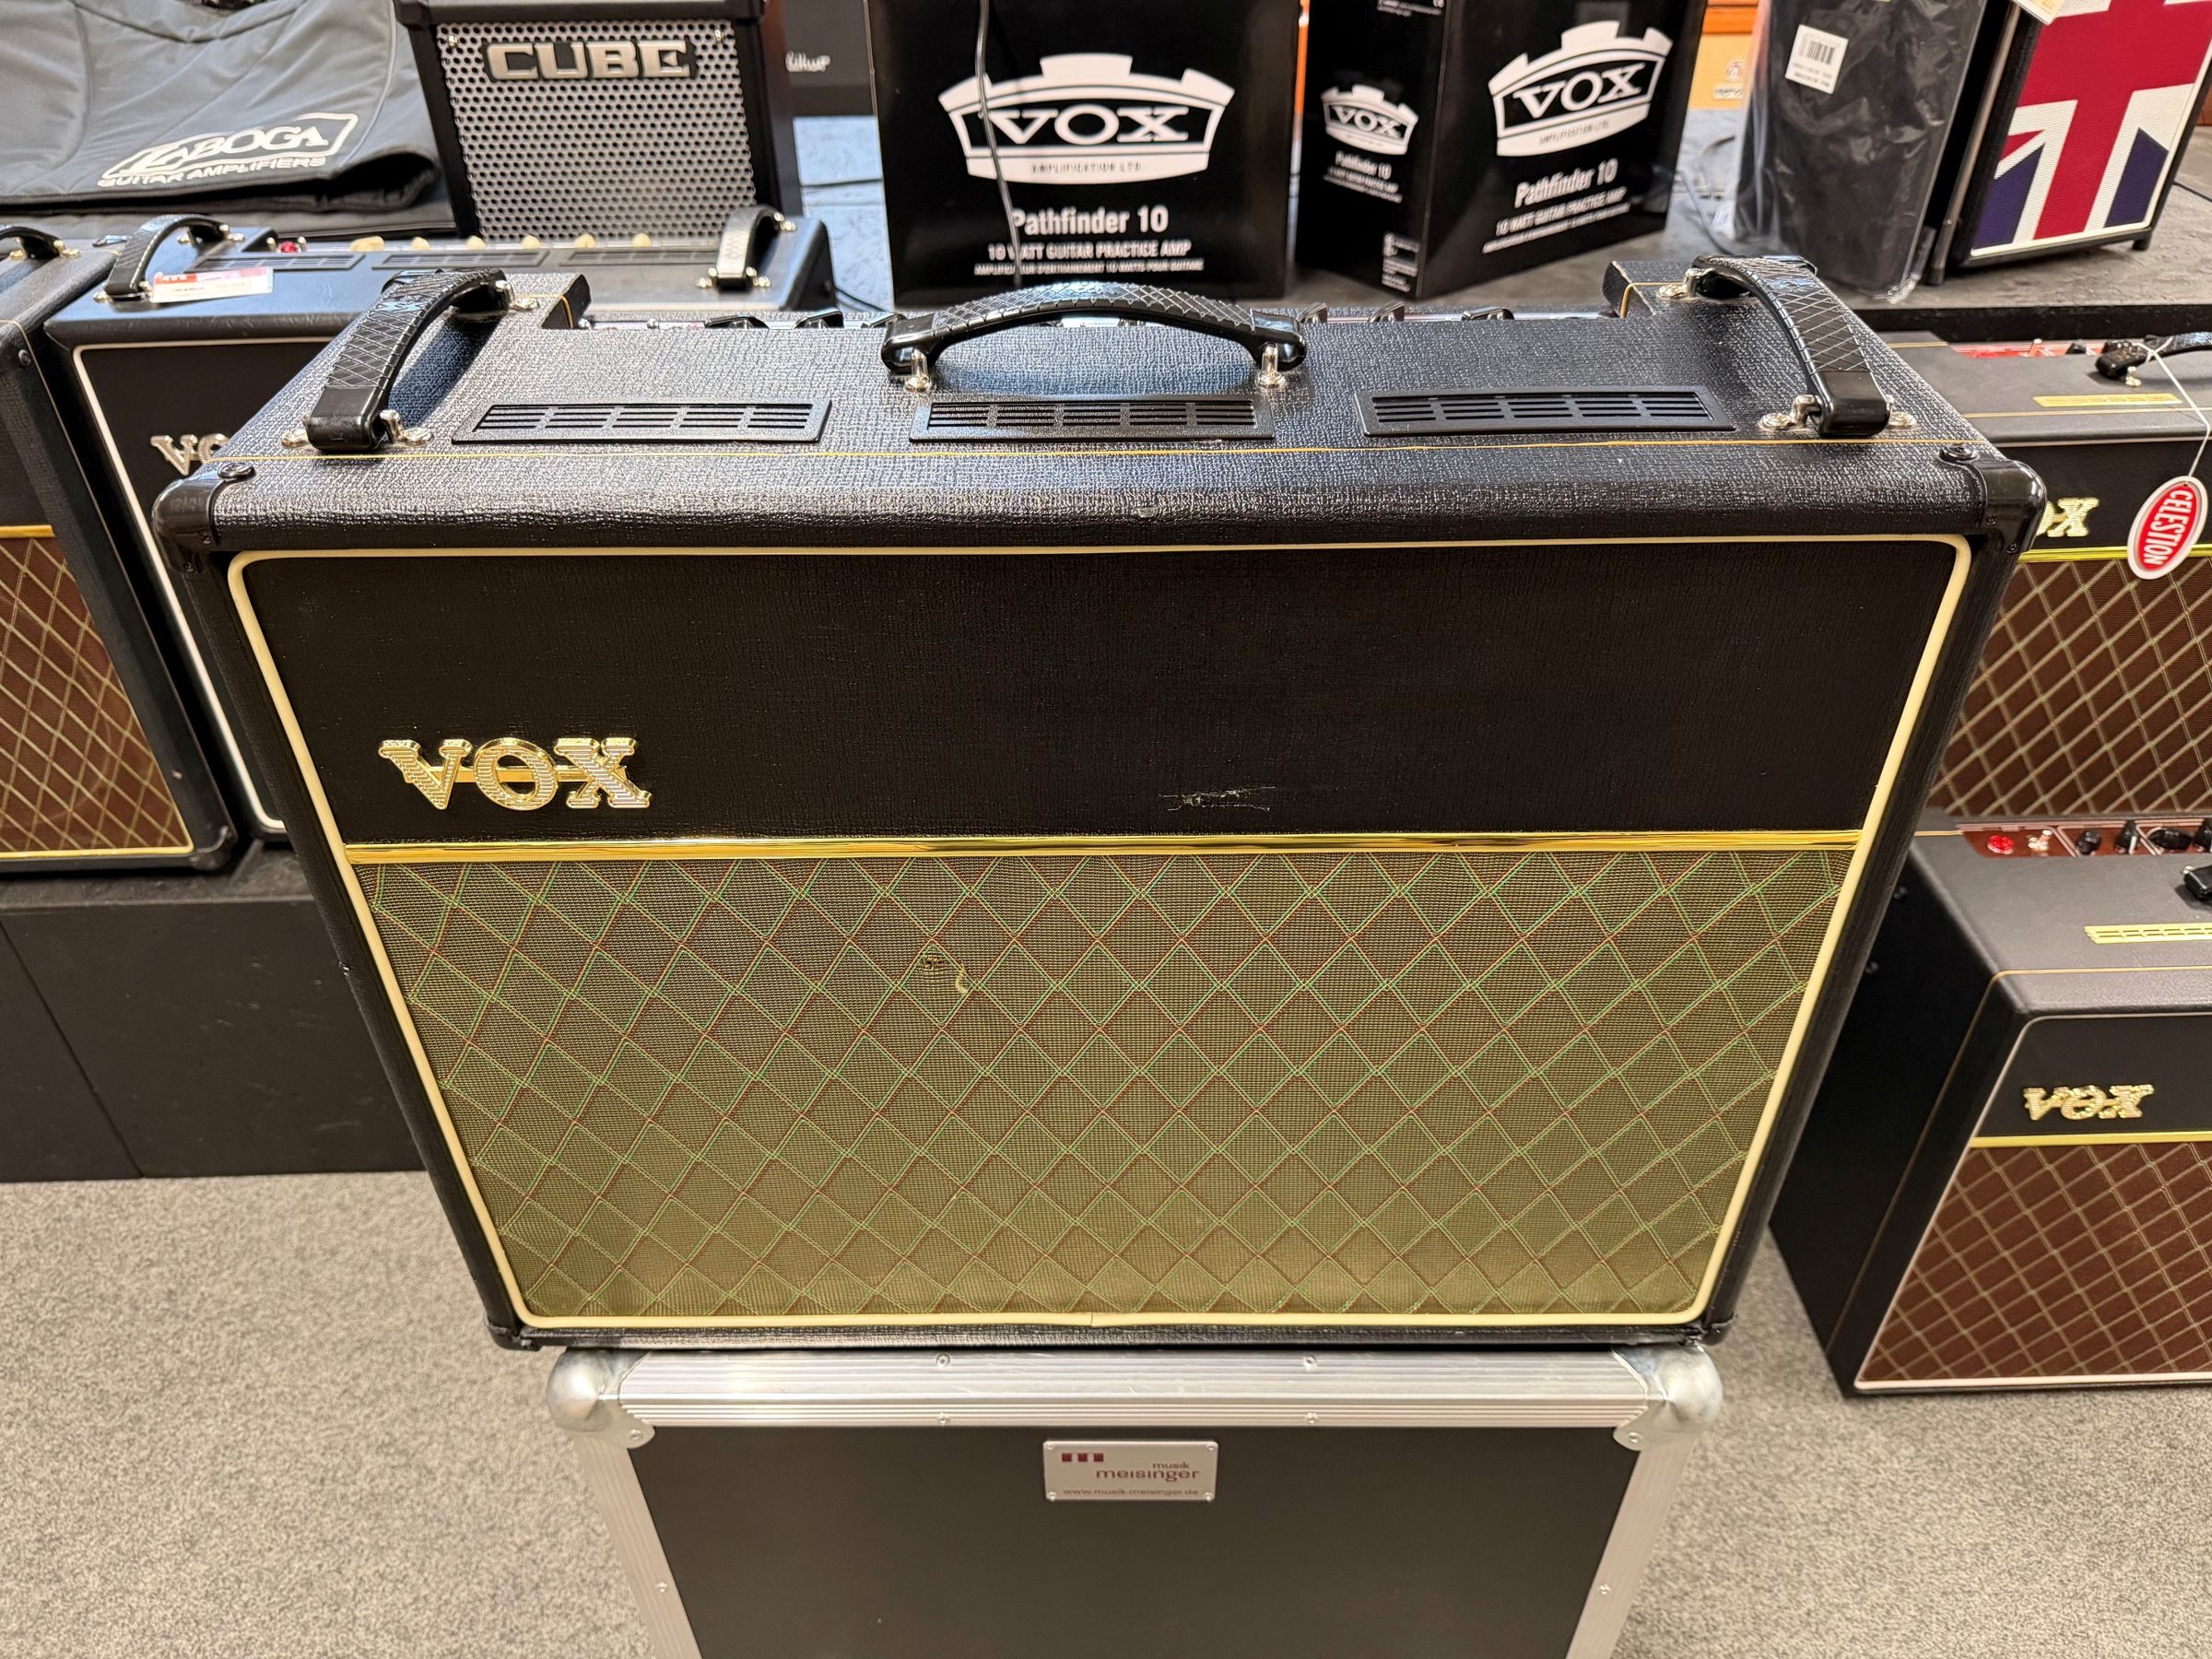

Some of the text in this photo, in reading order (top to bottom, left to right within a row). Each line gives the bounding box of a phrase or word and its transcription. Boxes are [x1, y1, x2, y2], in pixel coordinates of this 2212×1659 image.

[487, 41, 690, 79] CUBE
[1512, 62, 1645, 118] VOX
[988, 103, 1190, 146] VOX
[1331, 105, 1402, 139] VOX
[98, 155, 327, 187] GUITAR AMPLIFIERS
[1513, 158, 1619, 209] Pathfinder 10
[1012, 205, 1170, 236] Pathfinder 10
[1495, 218, 1510, 237] 10
[988, 243, 1006, 261] 10
[1045, 241, 1094, 260] GUITAR
[1095, 240, 1159, 259] PRACTICE
[1159, 239, 1193, 257] AMP
[2142, 489, 2194, 566] CELESTION
[378, 736, 653, 811] VOX
[2023, 1084, 2155, 1121] VOX
[1096, 1469, 1199, 1482] meisinger
[1152, 1461, 1189, 1469] musik
